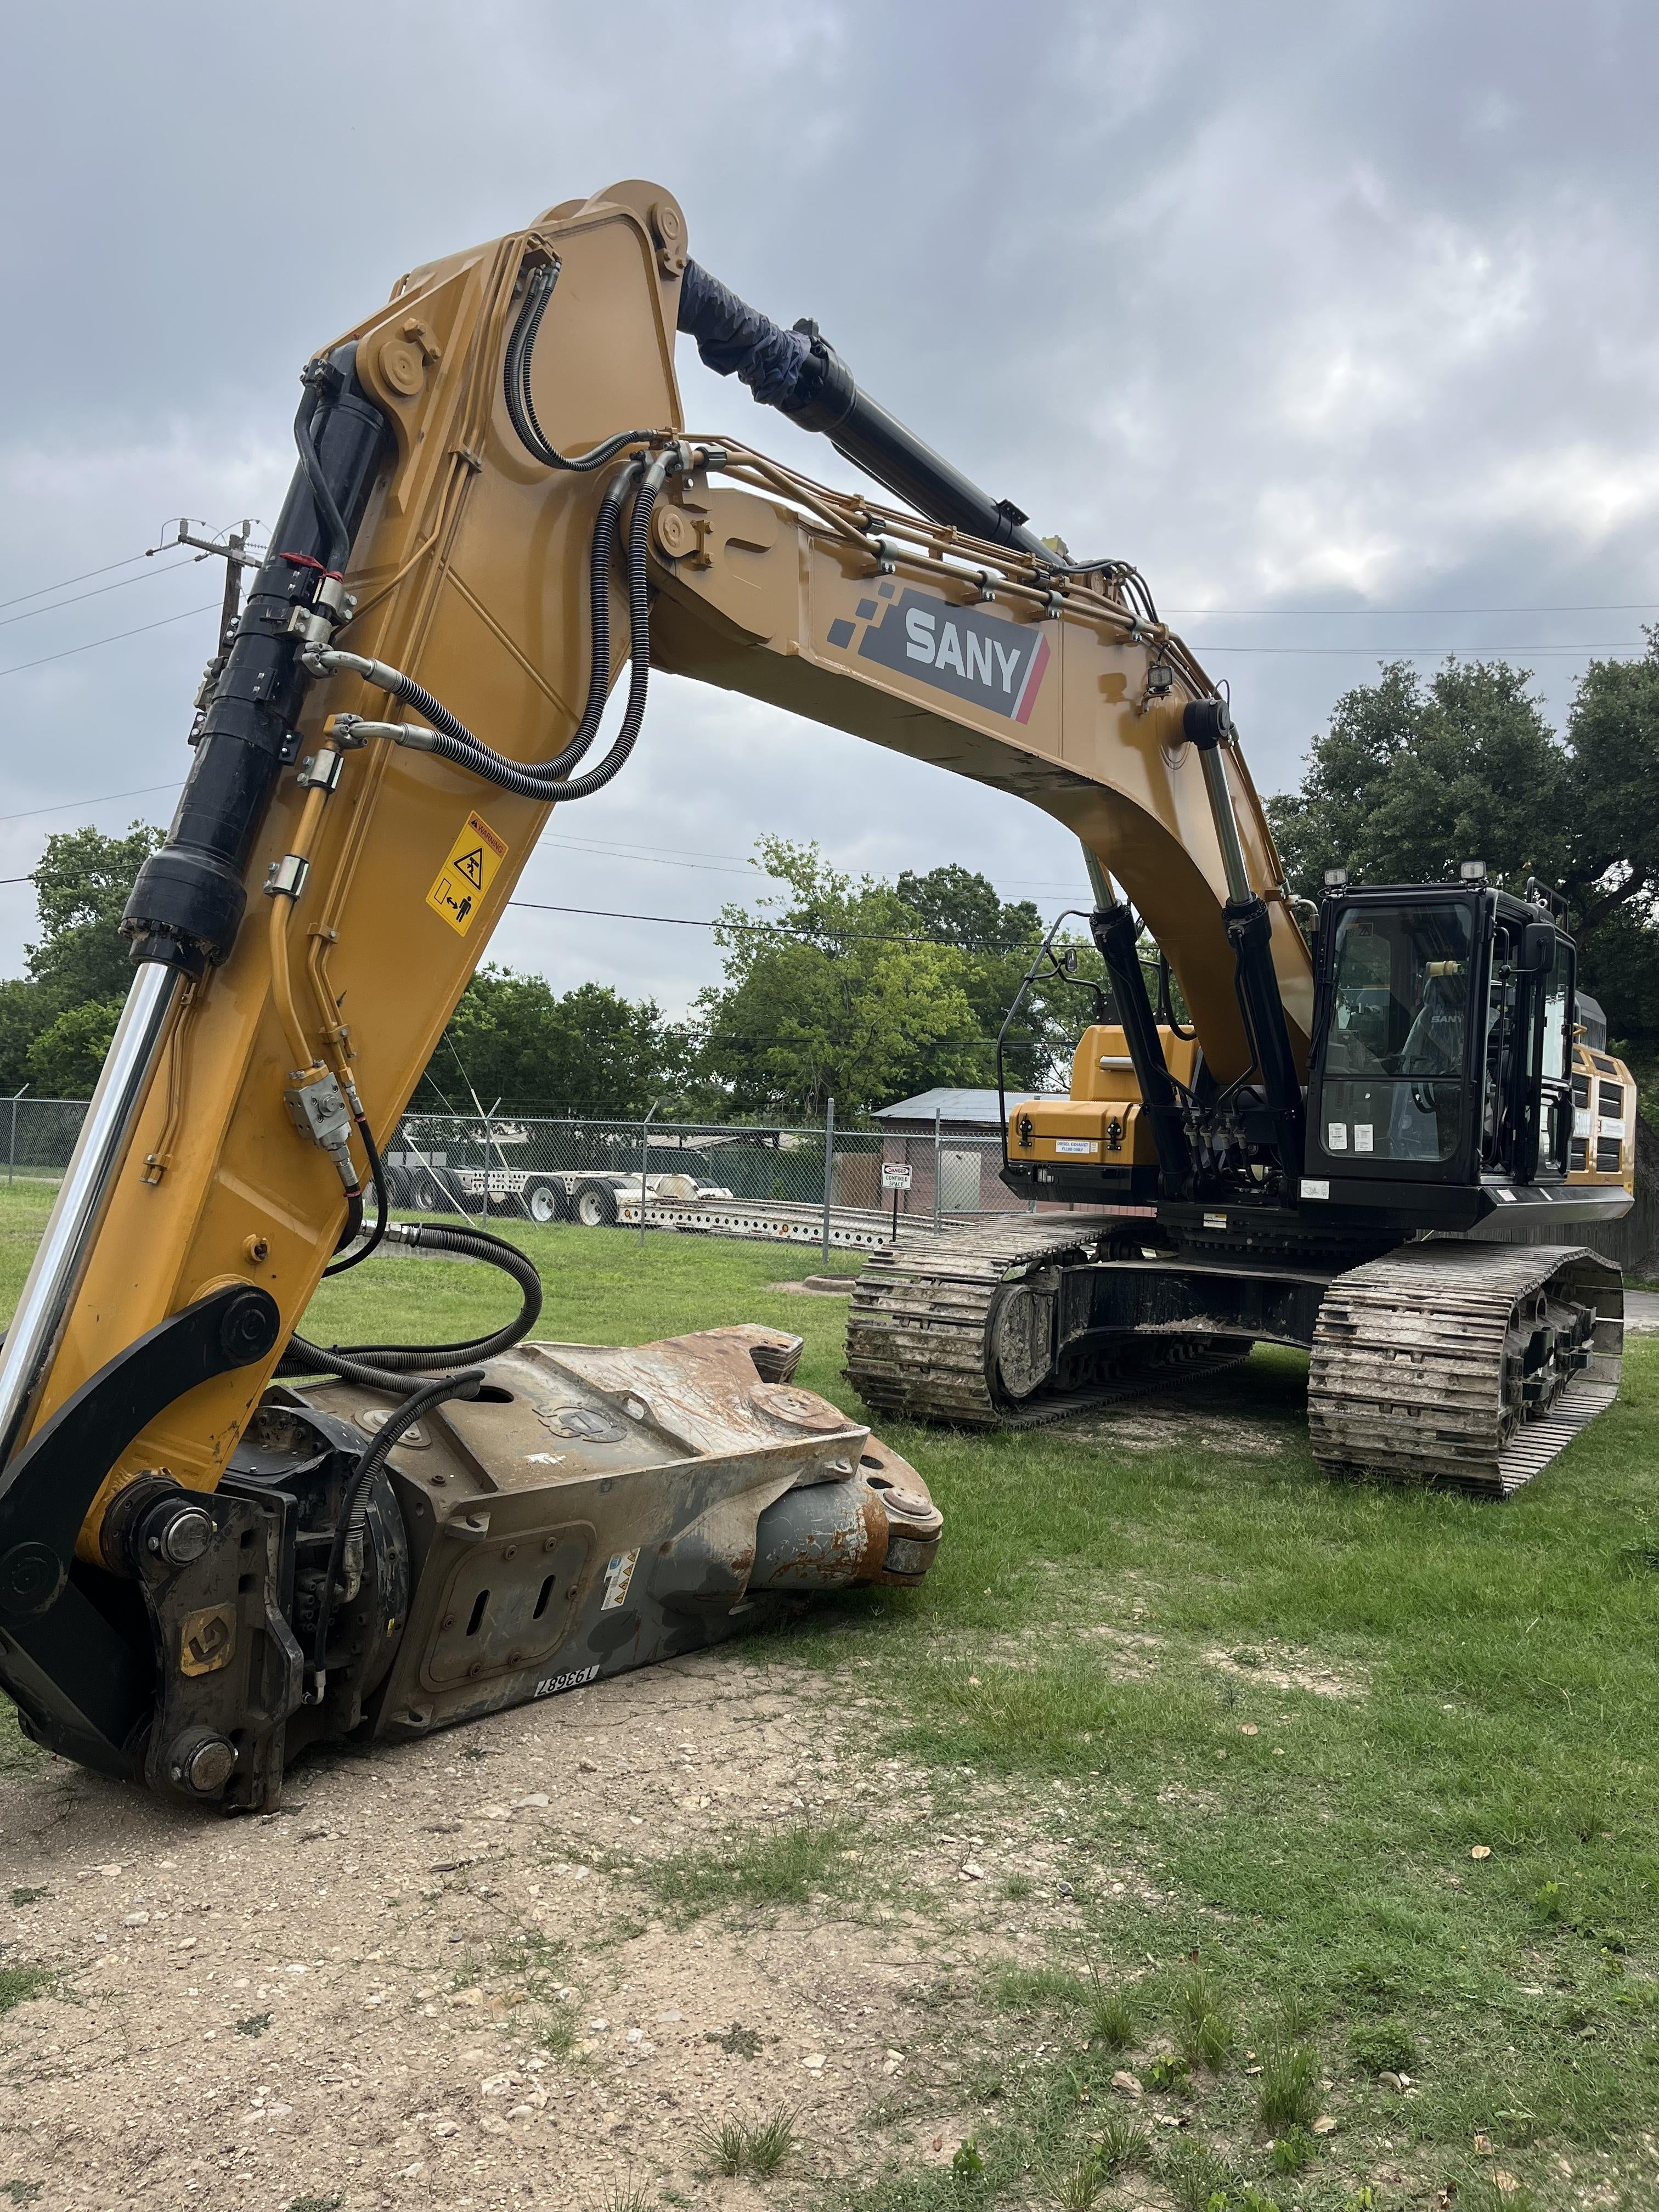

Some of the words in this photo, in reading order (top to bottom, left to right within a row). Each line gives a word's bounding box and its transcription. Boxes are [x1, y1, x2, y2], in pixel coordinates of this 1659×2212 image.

[905, 607, 1021, 693] SANY
[478, 825, 503, 853] WARNING
[1431, 1014, 1463, 1023] SANY
[537, 1666, 592, 1695] 193687
